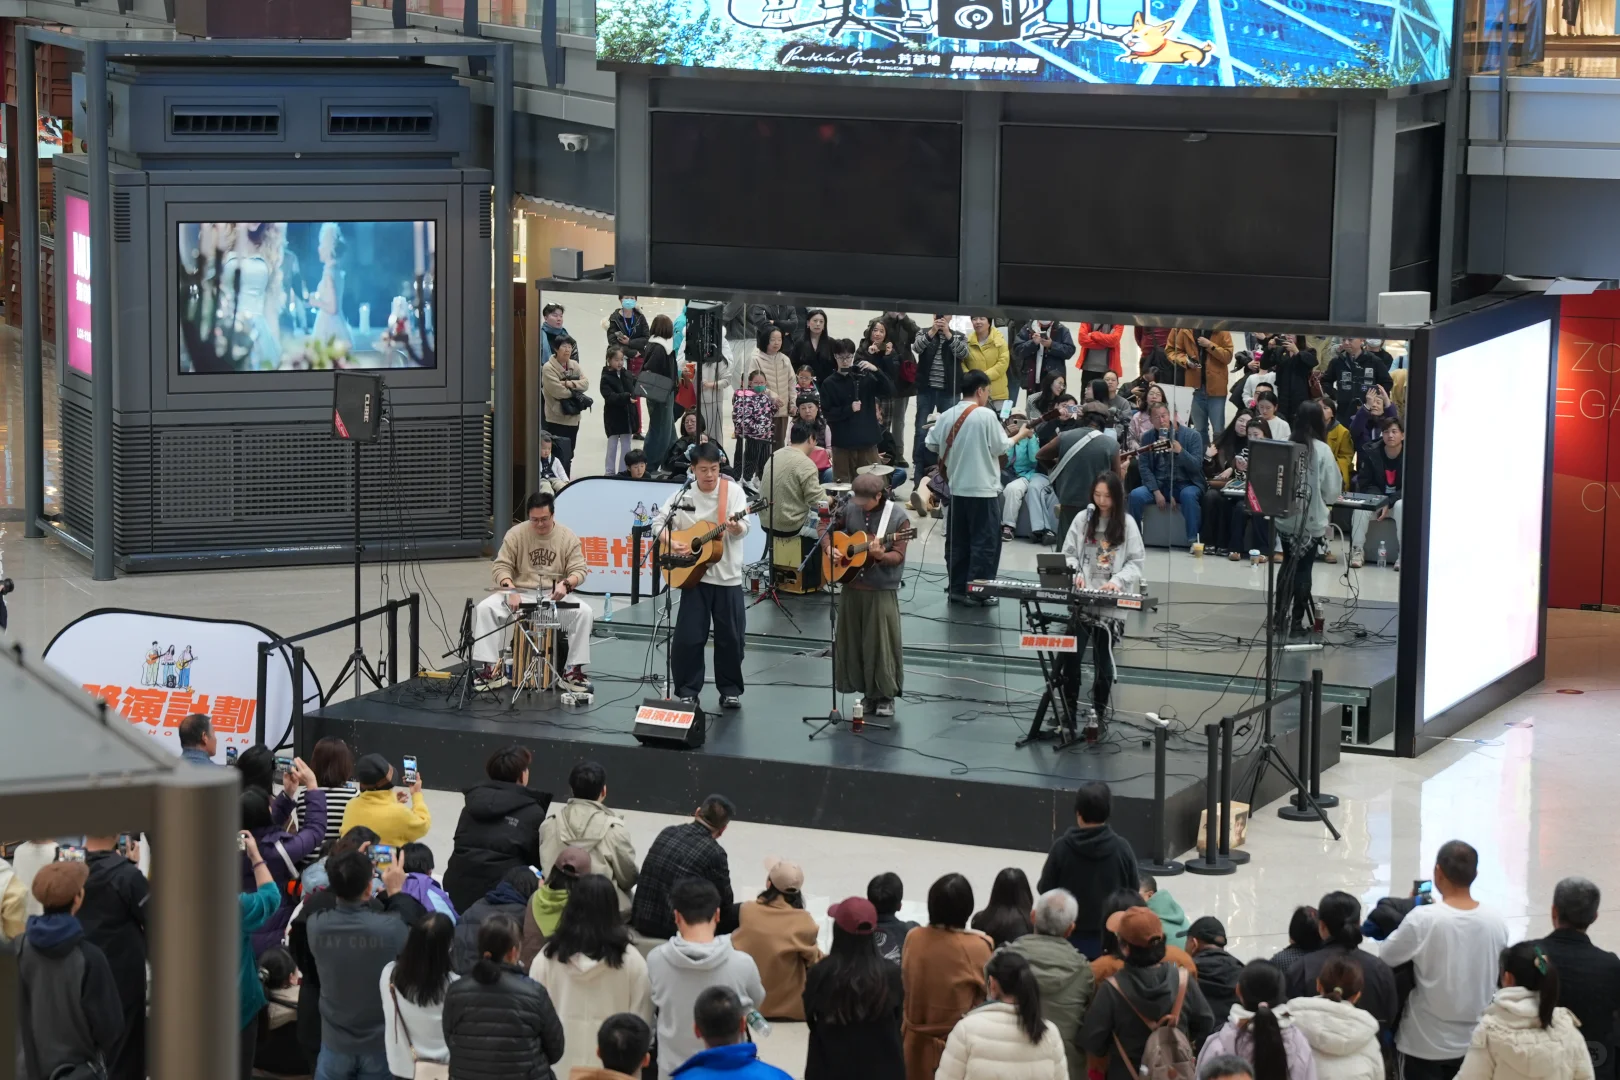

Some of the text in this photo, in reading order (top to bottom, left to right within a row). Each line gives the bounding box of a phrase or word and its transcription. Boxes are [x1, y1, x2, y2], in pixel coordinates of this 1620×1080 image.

[846, 51, 897, 66] Green
[897, 53, 941, 66] 芳草地
[1043, 591, 1068, 600] Roland
